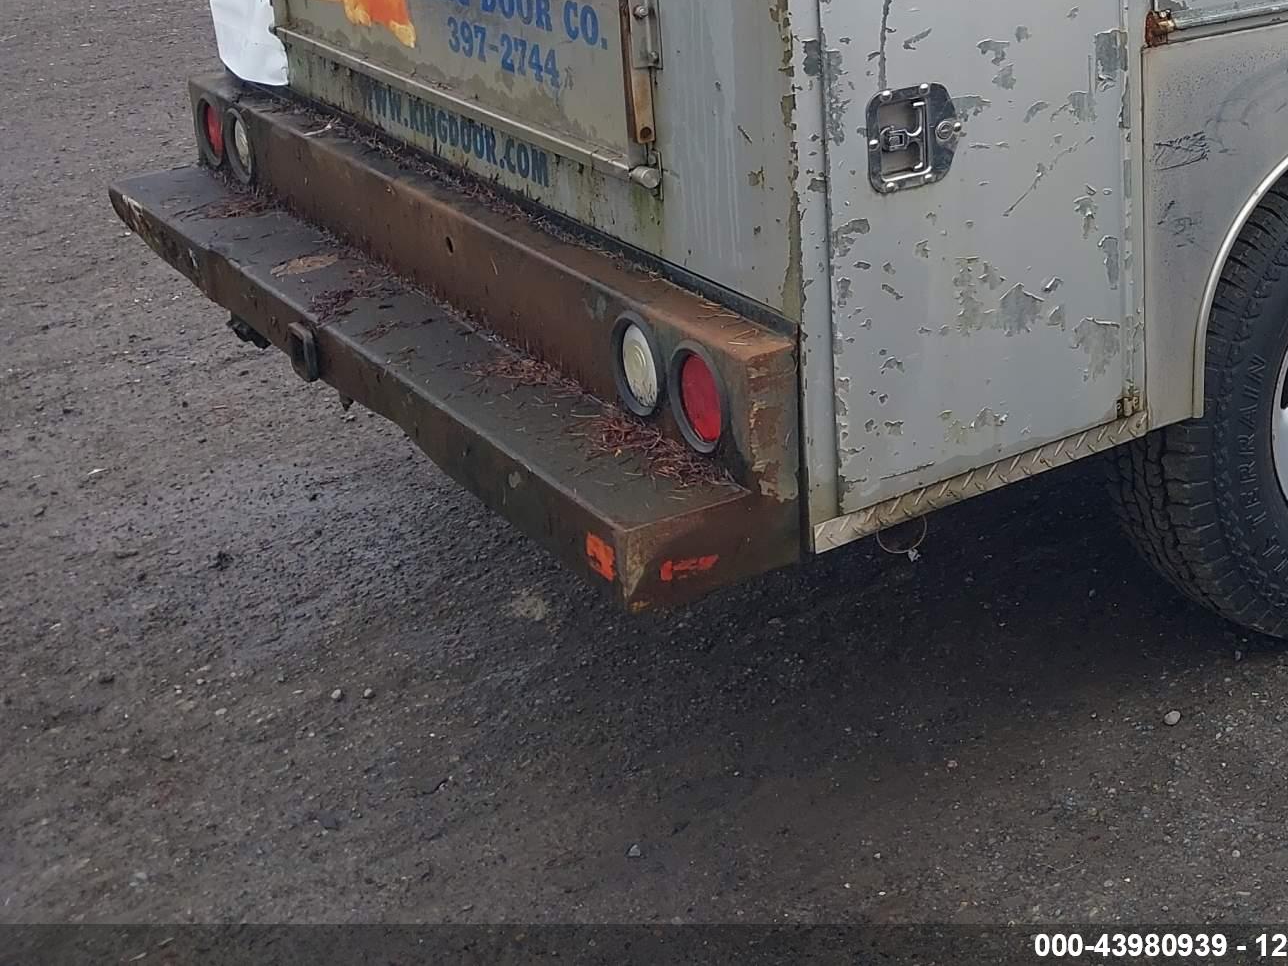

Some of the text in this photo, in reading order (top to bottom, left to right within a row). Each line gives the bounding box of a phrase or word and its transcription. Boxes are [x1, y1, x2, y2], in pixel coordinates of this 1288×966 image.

[446, 16, 560, 89] 397-2744
[563, 0, 608, 51] CO.
[1239, 353, 1267, 533] TERRAIN
